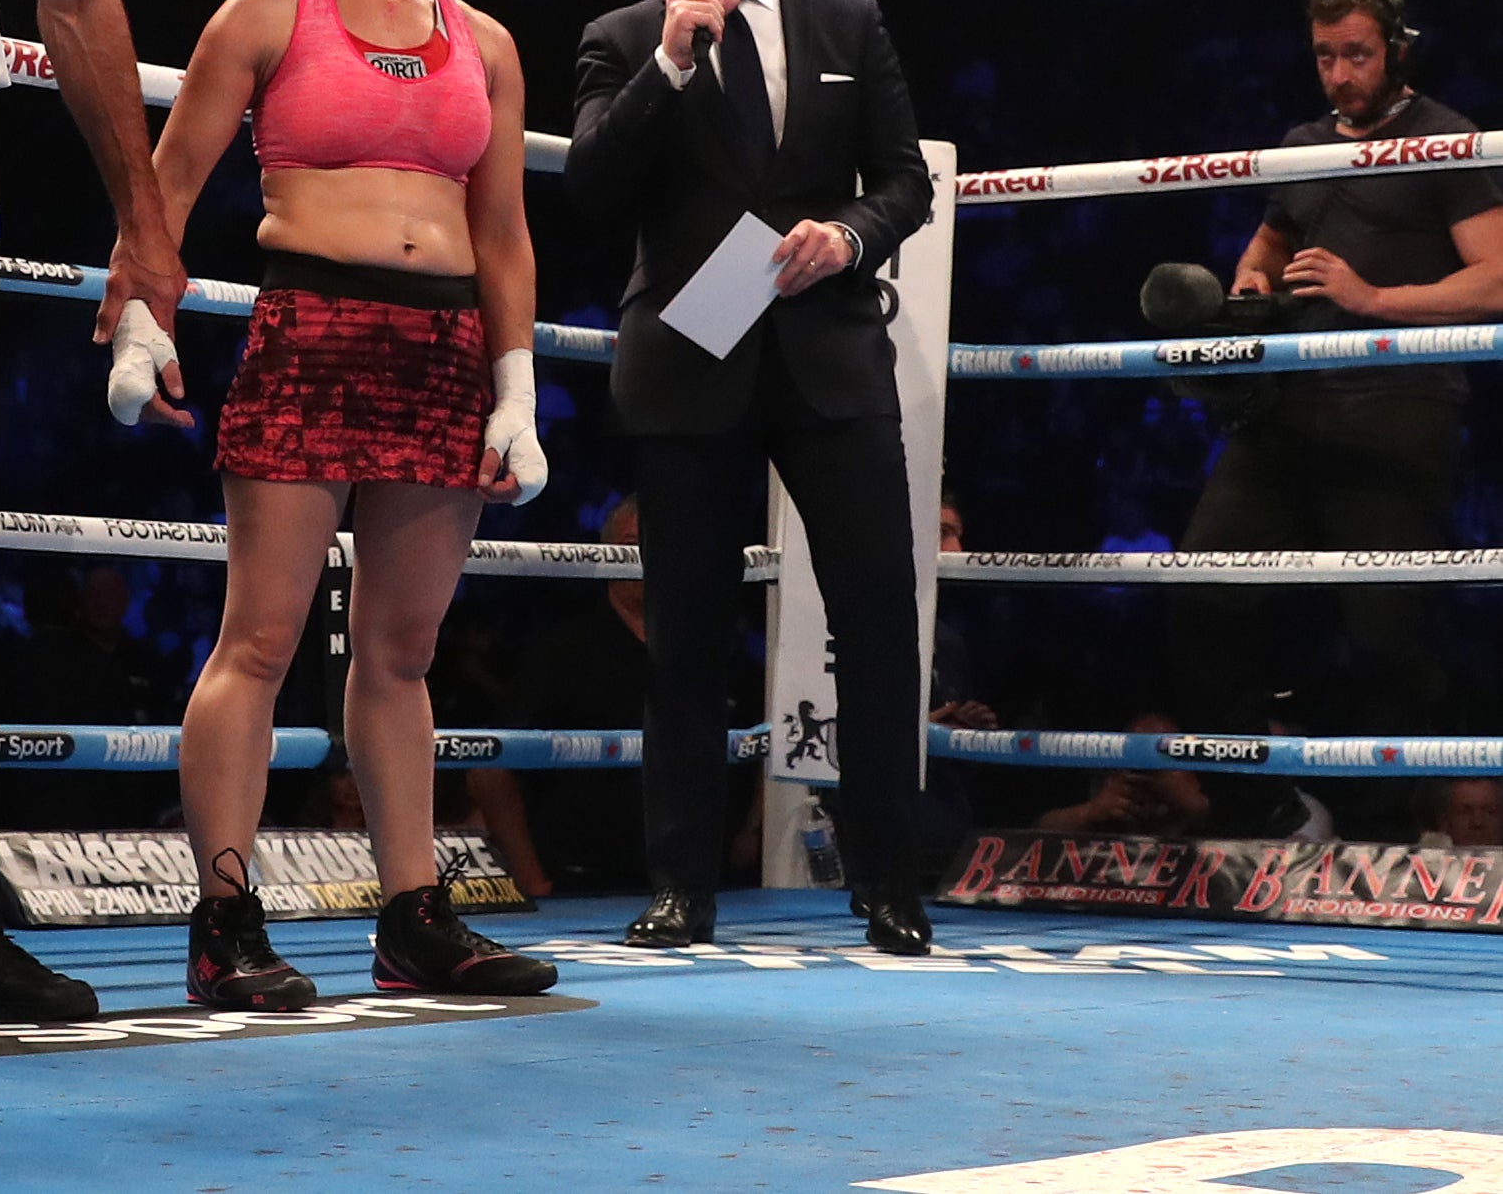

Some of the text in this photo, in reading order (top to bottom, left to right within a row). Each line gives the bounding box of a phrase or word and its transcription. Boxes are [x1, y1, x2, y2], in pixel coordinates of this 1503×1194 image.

[1351, 132, 1475, 168] 32Red
[1138, 152, 1253, 184] 32Red
[16, 258, 75, 280] Sport
[1166, 343, 1256, 365] BT Sport
[1298, 327, 1495, 361] FRANK WARREN
[951, 347, 1122, 373] FRANK WARREN
[8, 735, 64, 759] Sport
[104, 733, 171, 762] FRANK
[450, 738, 494, 758] Sport
[950, 730, 1126, 757] FRANK WARREN
[1168, 739, 1259, 760] BT Sport
[1303, 741, 1502, 767] FRANK WARREN
[947, 836, 1225, 908] BANNER
[255, 884, 318, 911] RENA
[997, 885, 1158, 903] PROMOTIONS
[1284, 898, 1468, 921] PROMOTIONS
[553, 953, 1289, 976] STEEL
